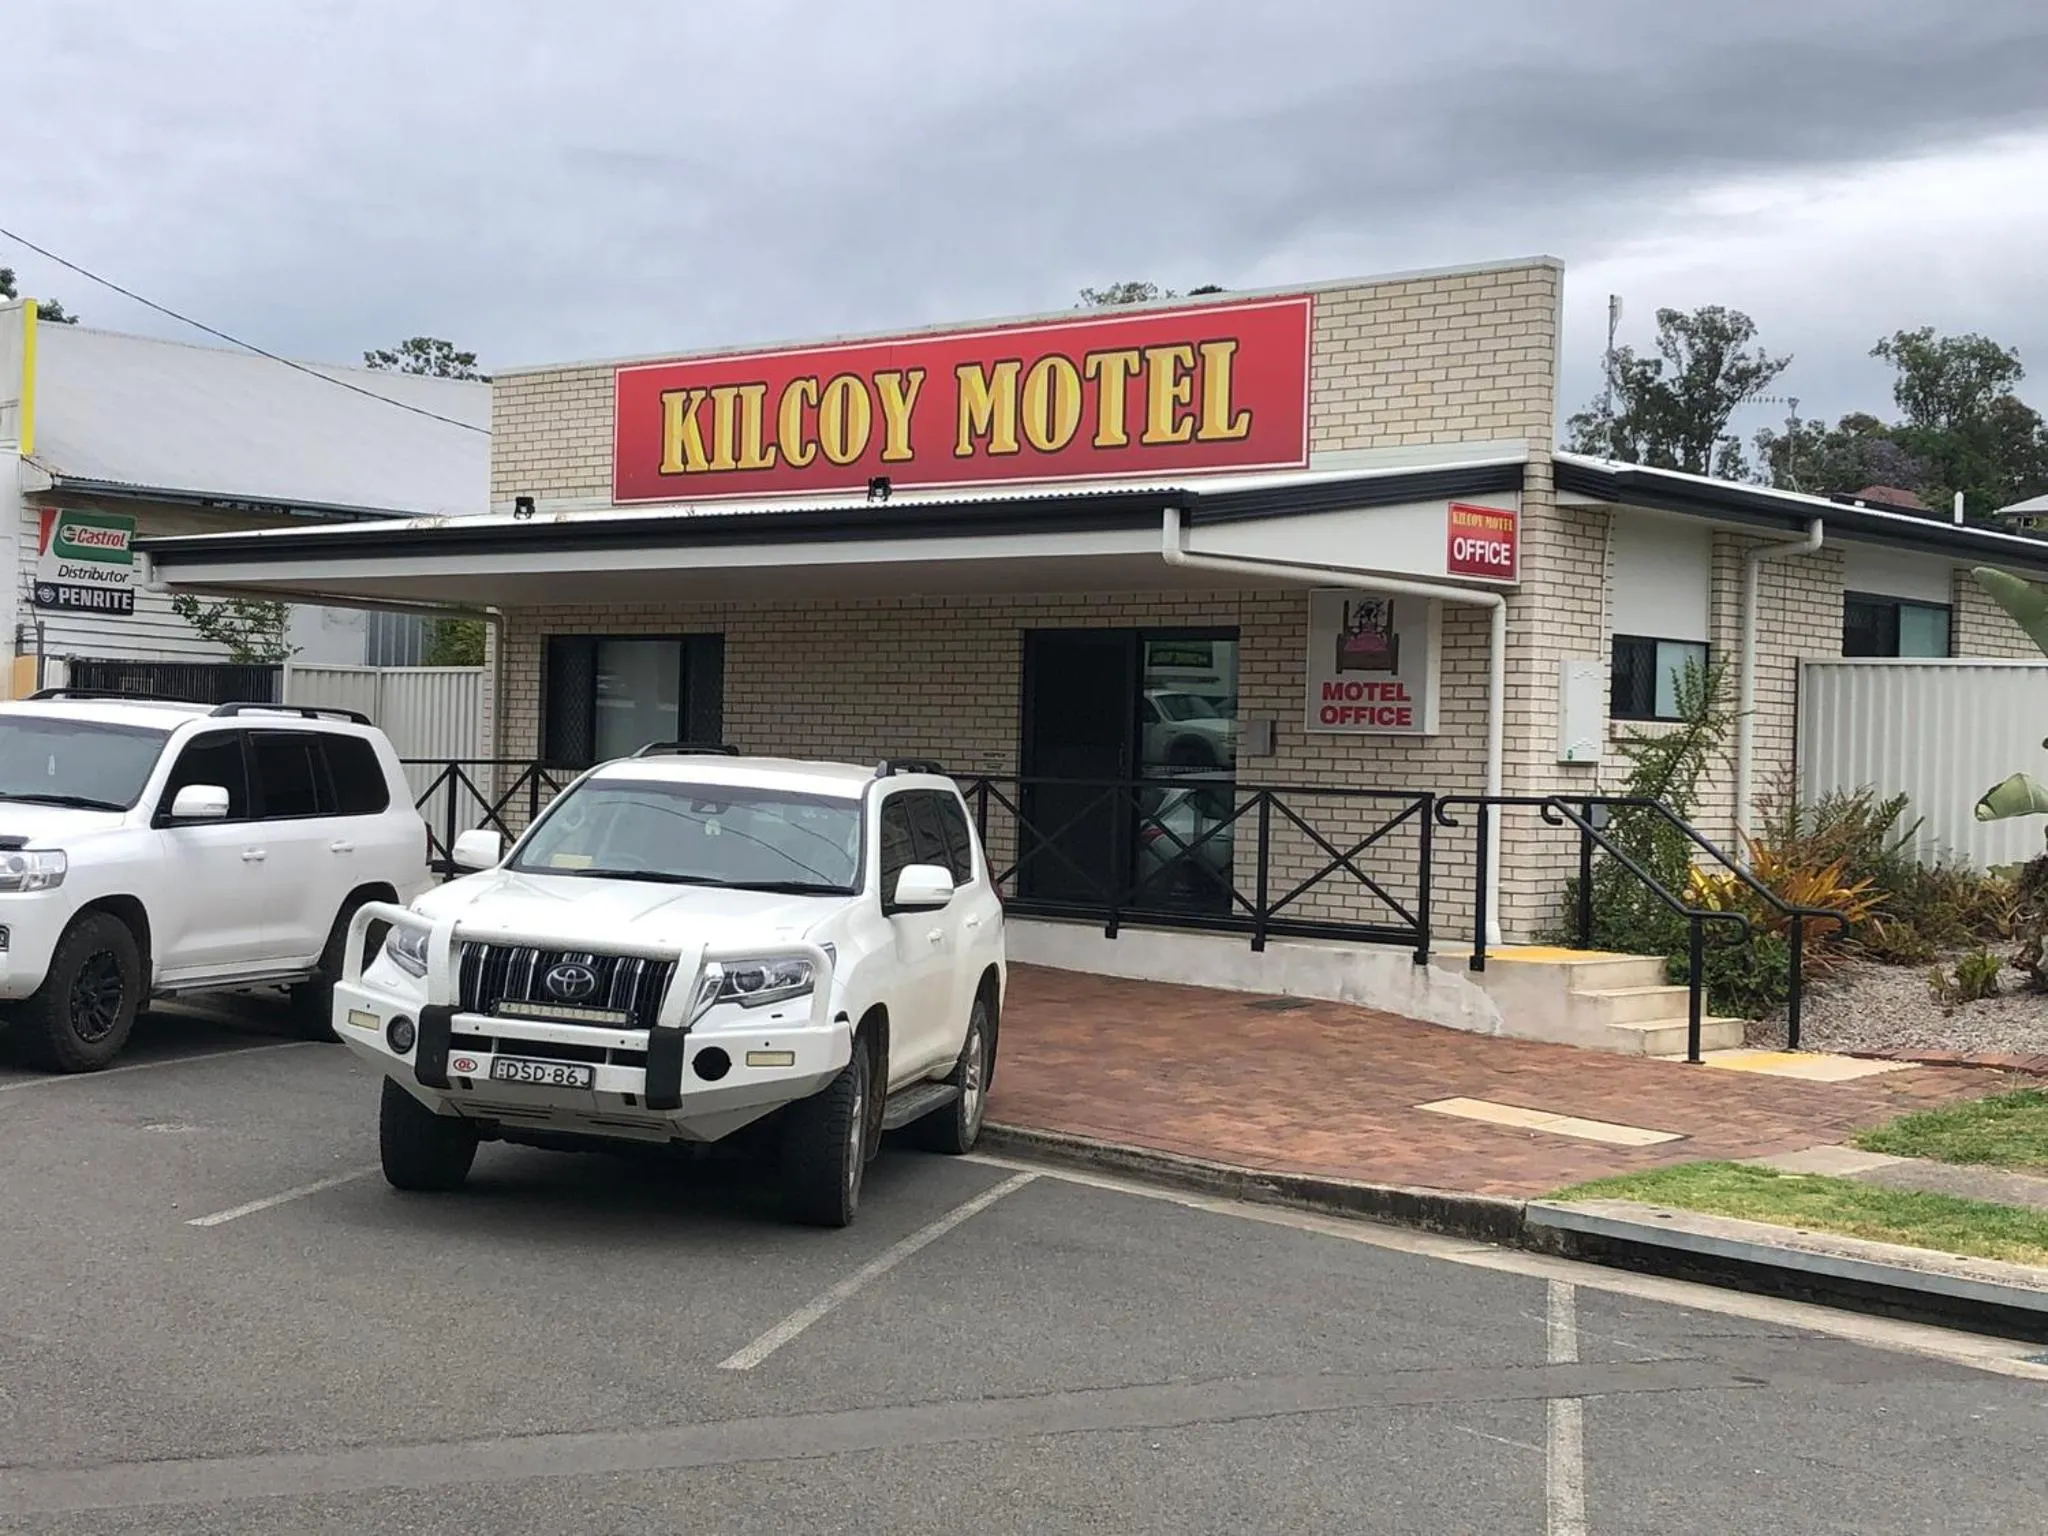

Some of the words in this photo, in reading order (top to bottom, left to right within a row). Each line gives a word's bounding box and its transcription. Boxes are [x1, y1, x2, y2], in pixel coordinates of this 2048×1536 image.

[659, 367, 927, 475] KILCOY
[954, 339, 1252, 458] MOTEL
[77, 527, 126, 548] Castrol
[1453, 537, 1511, 566] OFFICE
[57, 564, 130, 583] Distributor
[58, 587, 132, 610] PENRITE
[1322, 681, 1412, 702] MOTEL
[1319, 704, 1412, 726] OFFICE
